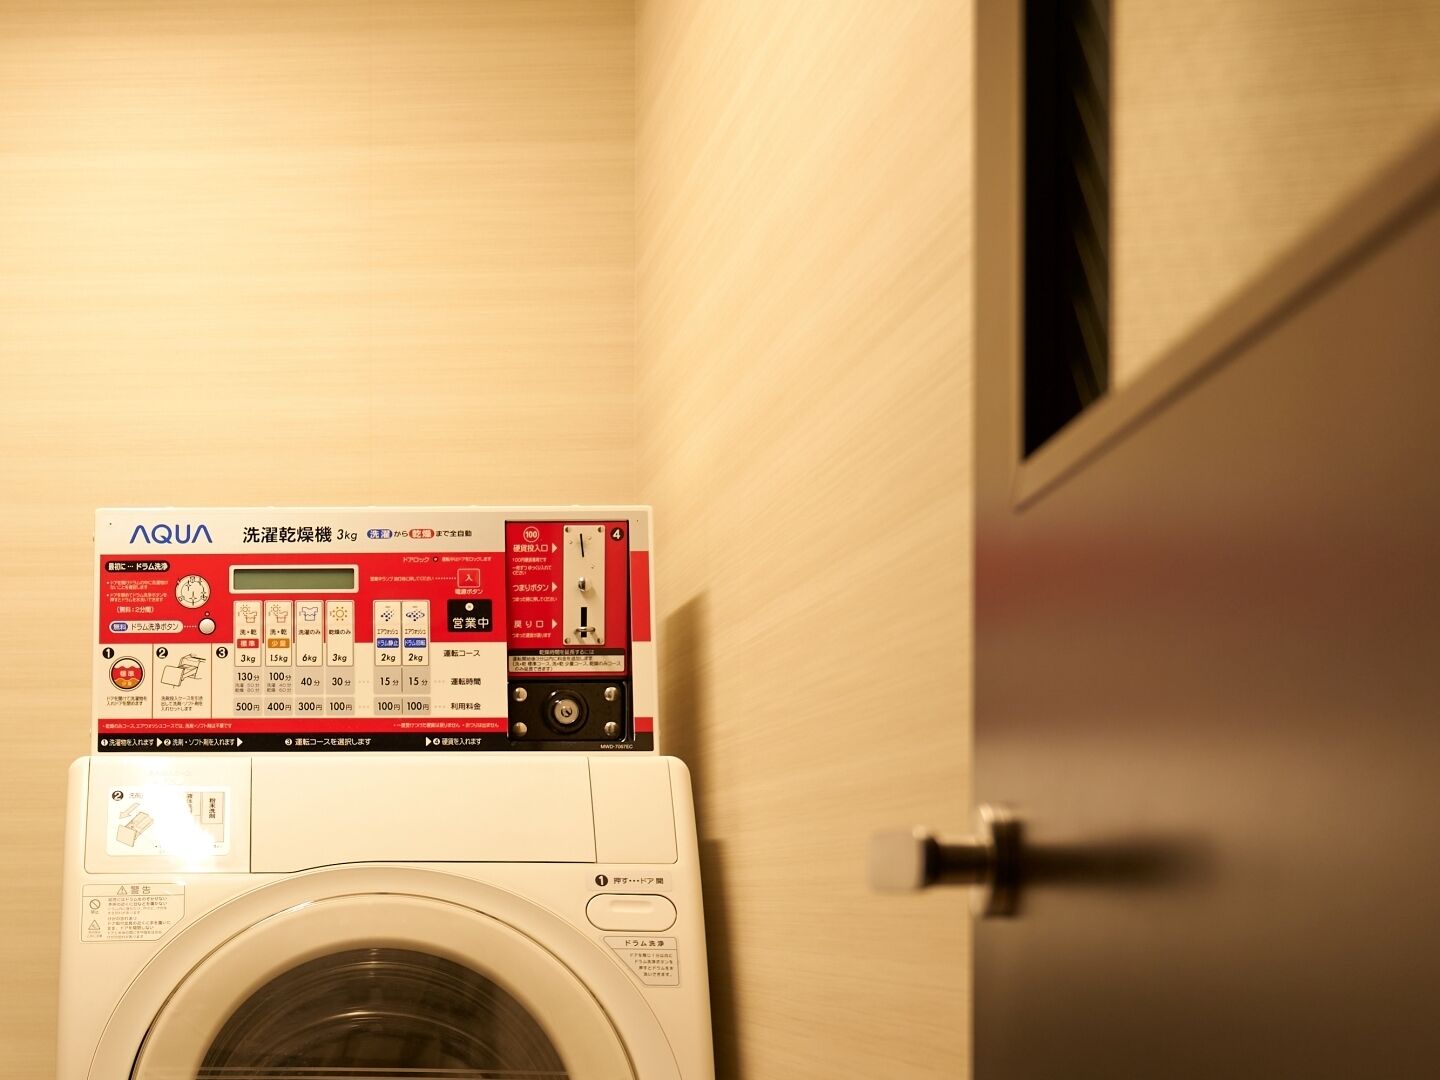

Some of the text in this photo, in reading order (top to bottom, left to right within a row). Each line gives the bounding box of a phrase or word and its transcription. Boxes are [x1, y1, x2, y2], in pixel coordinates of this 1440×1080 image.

[130, 525, 212, 544] AQUA
[243, 527, 357, 543] 洗濯乾燥機 3kg
[453, 617, 489, 629] 営業中
[241, 655, 255, 663] 3kg
[302, 654, 317, 662] 6kg
[333, 654, 347, 662] 3kg
[381, 654, 396, 662] 2kg
[408, 654, 423, 662] 2kg
[269, 672, 291, 680] 100分
[301, 678, 320, 686] 40分
[332, 678, 351, 686] 30分
[380, 677, 398, 685] 15分
[409, 677, 427, 685] 15分
[236, 703, 259, 711] 500円
[267, 703, 291, 711] 400円
[299, 702, 322, 711] 300円
[330, 702, 352, 710] 100円
[378, 702, 400, 710] 100円
[407, 702, 429, 710] 100円
[295, 738, 371, 746] 運転コースを選択します
